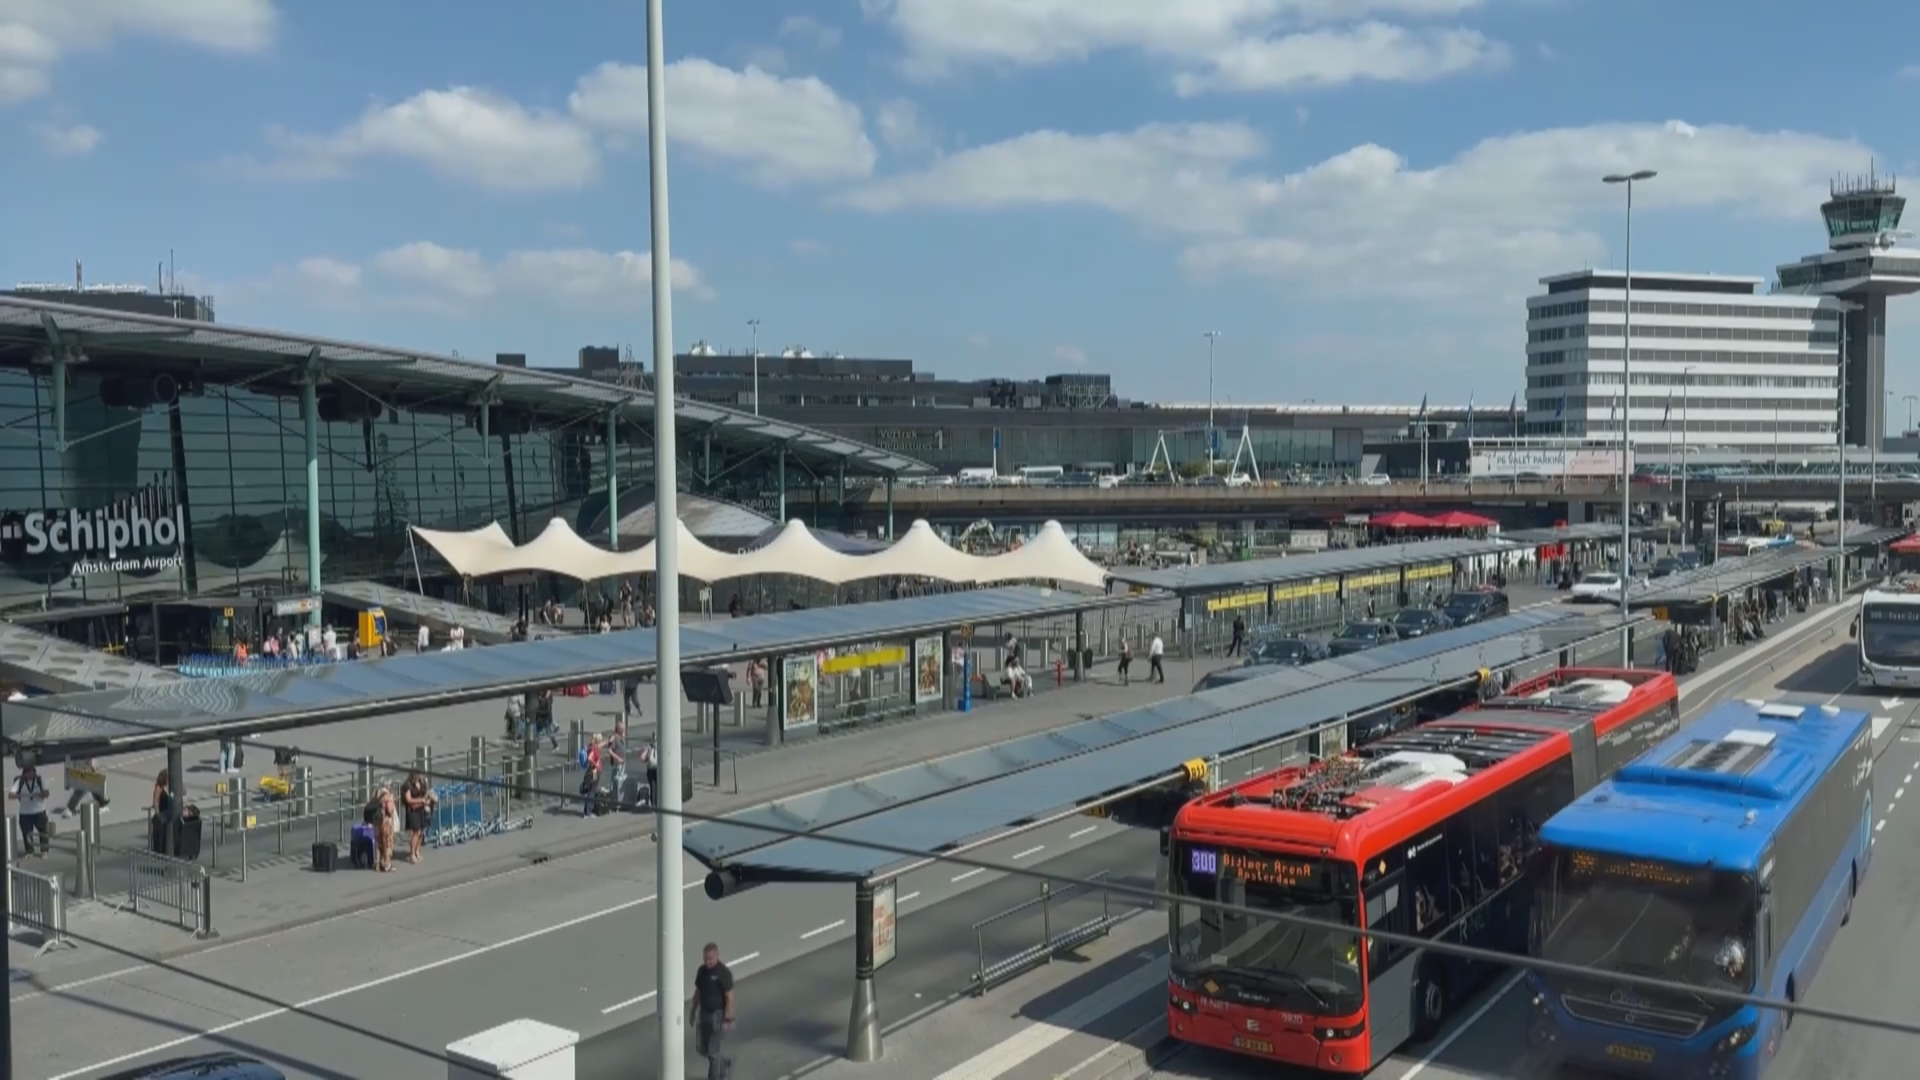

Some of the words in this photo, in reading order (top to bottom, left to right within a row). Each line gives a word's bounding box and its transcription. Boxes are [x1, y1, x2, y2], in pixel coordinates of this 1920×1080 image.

[880, 429, 917, 439] Vertrek
[1533, 455, 1566, 465] PARKING
[25, 503, 185, 560] Schiphol
[72, 560, 140, 574] Amsterdam
[144, 556, 183, 571] Airport
[1192, 850, 1217, 874] 300
[1223, 853, 1268, 871] Bijlmer
[1275, 860, 1311, 877] ArenA
[1238, 867, 1297, 886] Amsterdam
